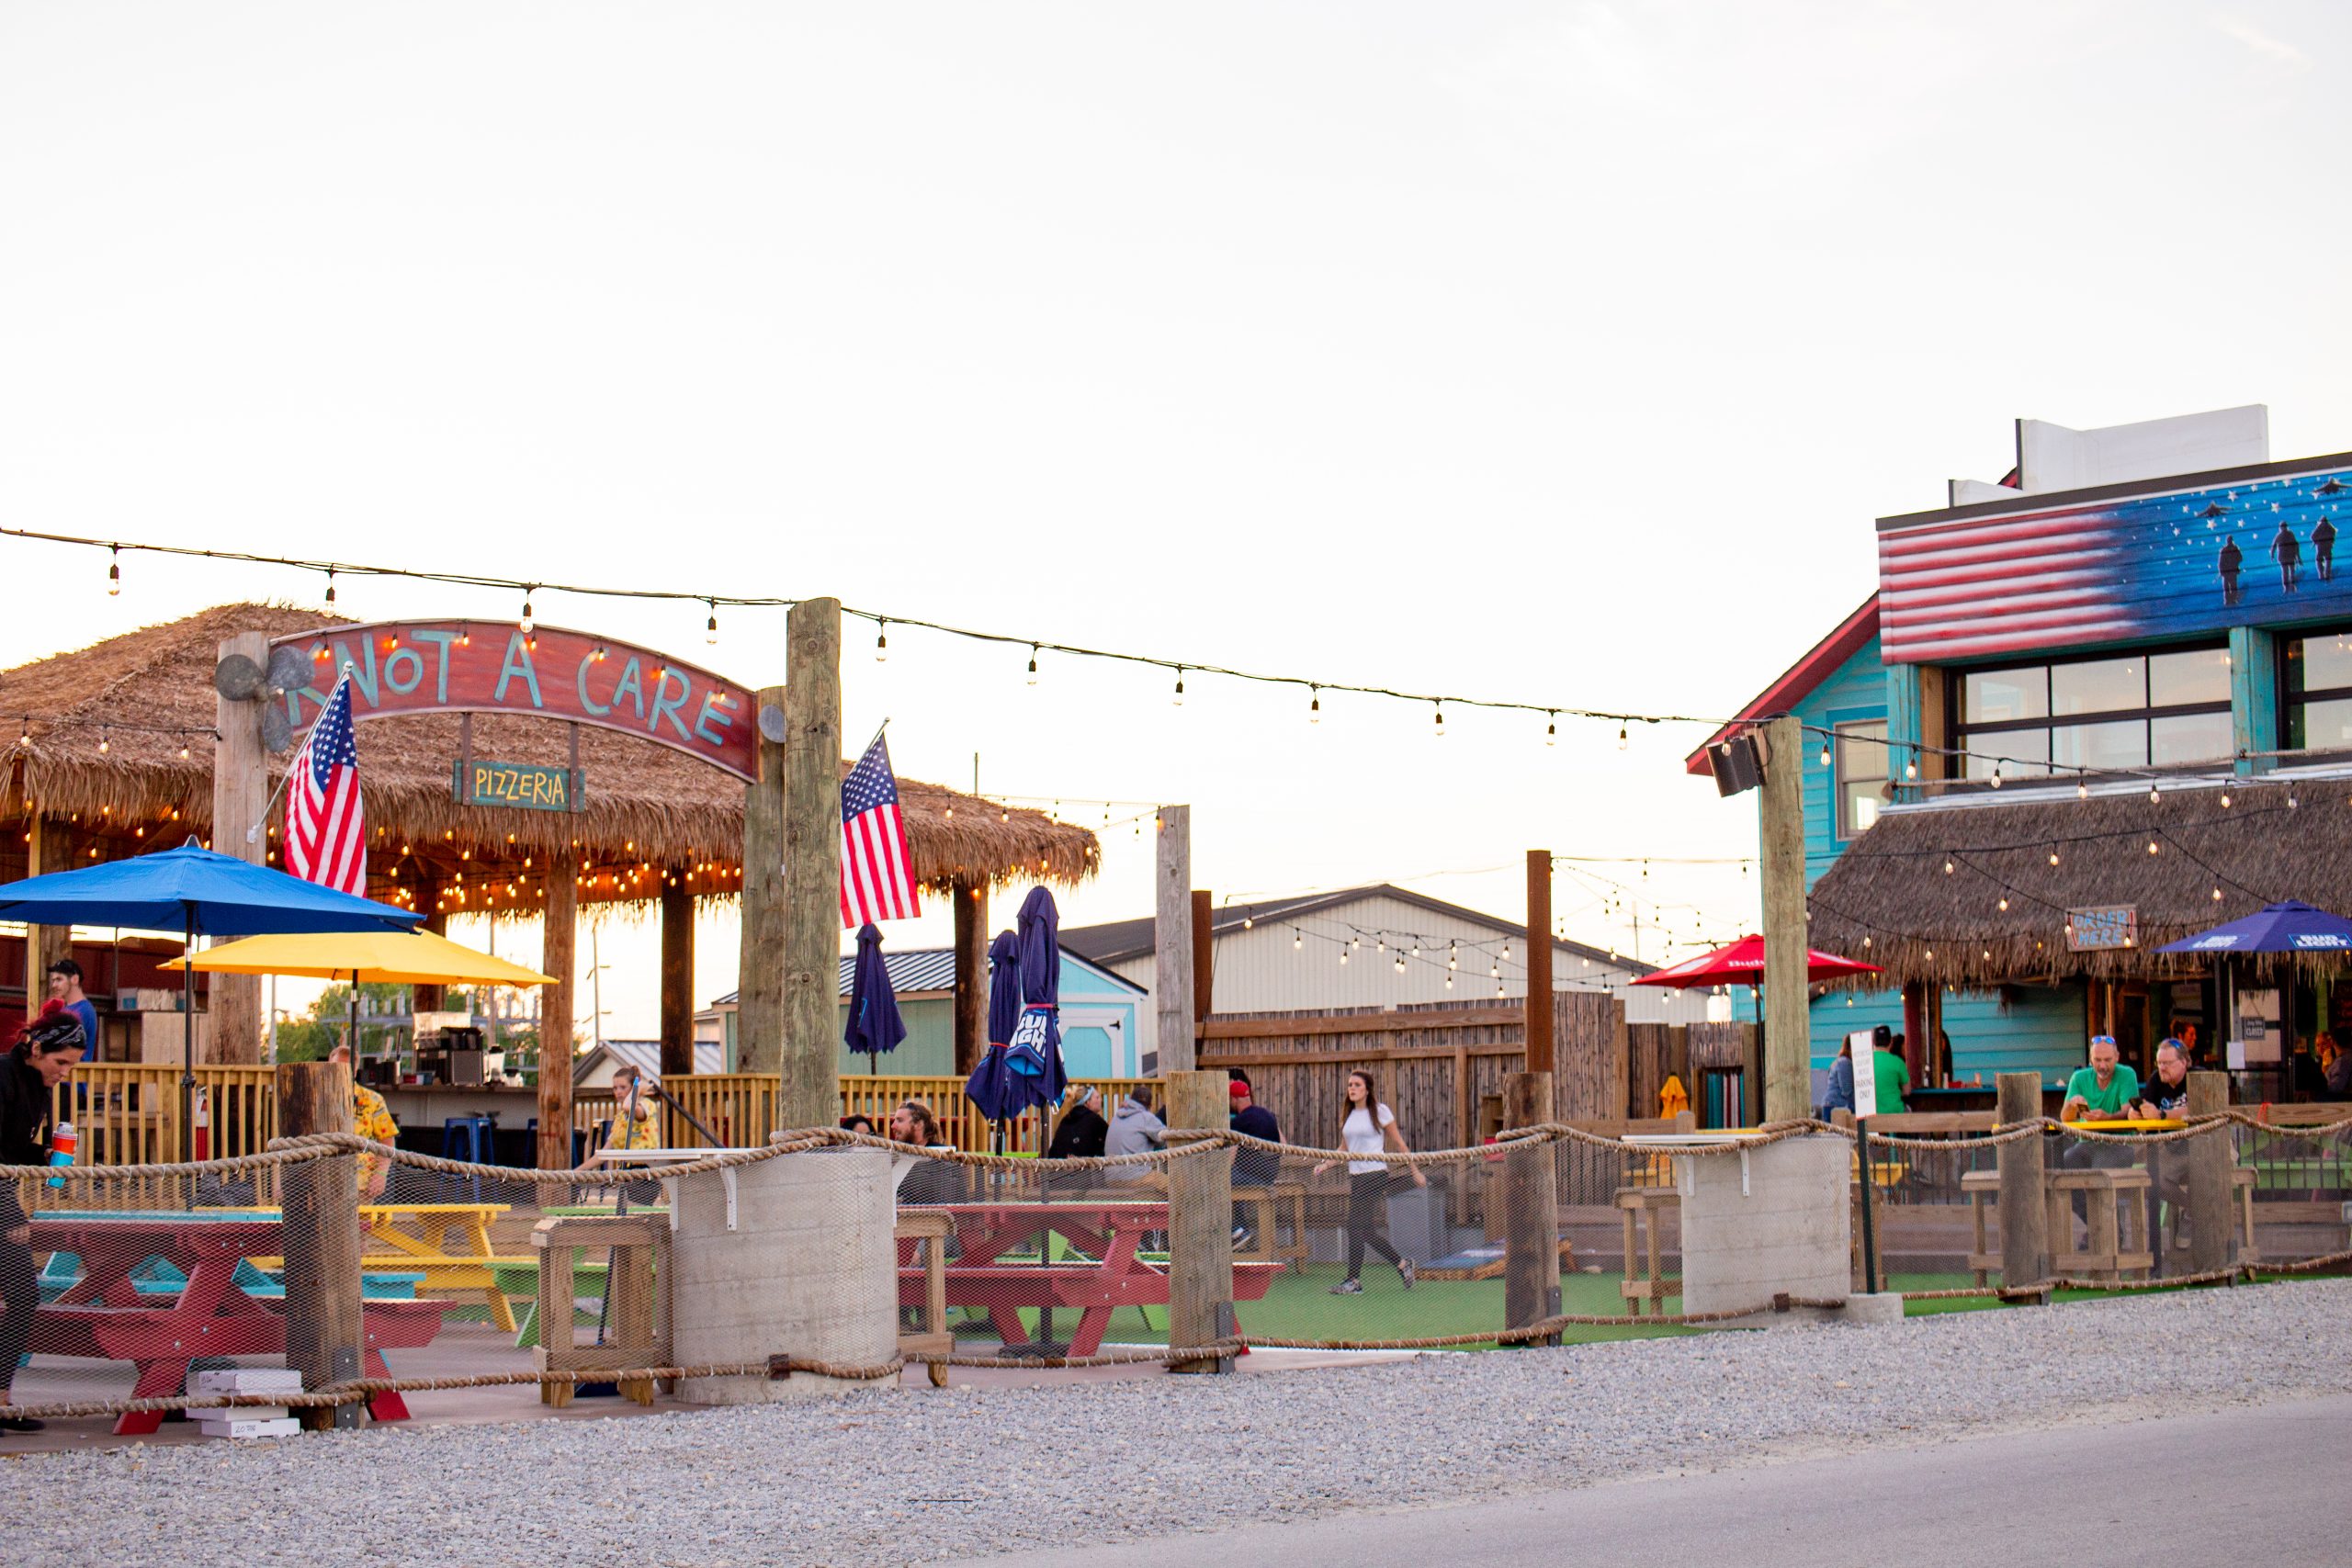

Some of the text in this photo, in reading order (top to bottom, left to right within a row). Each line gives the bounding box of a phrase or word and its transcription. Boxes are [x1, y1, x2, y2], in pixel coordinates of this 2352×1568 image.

[493, 631, 544, 708] A
[577, 647, 739, 748] CARE
[475, 768, 565, 806] PIZZERIA
[2074, 910, 2128, 928] ORDER
[2078, 929, 2122, 947] HERE
